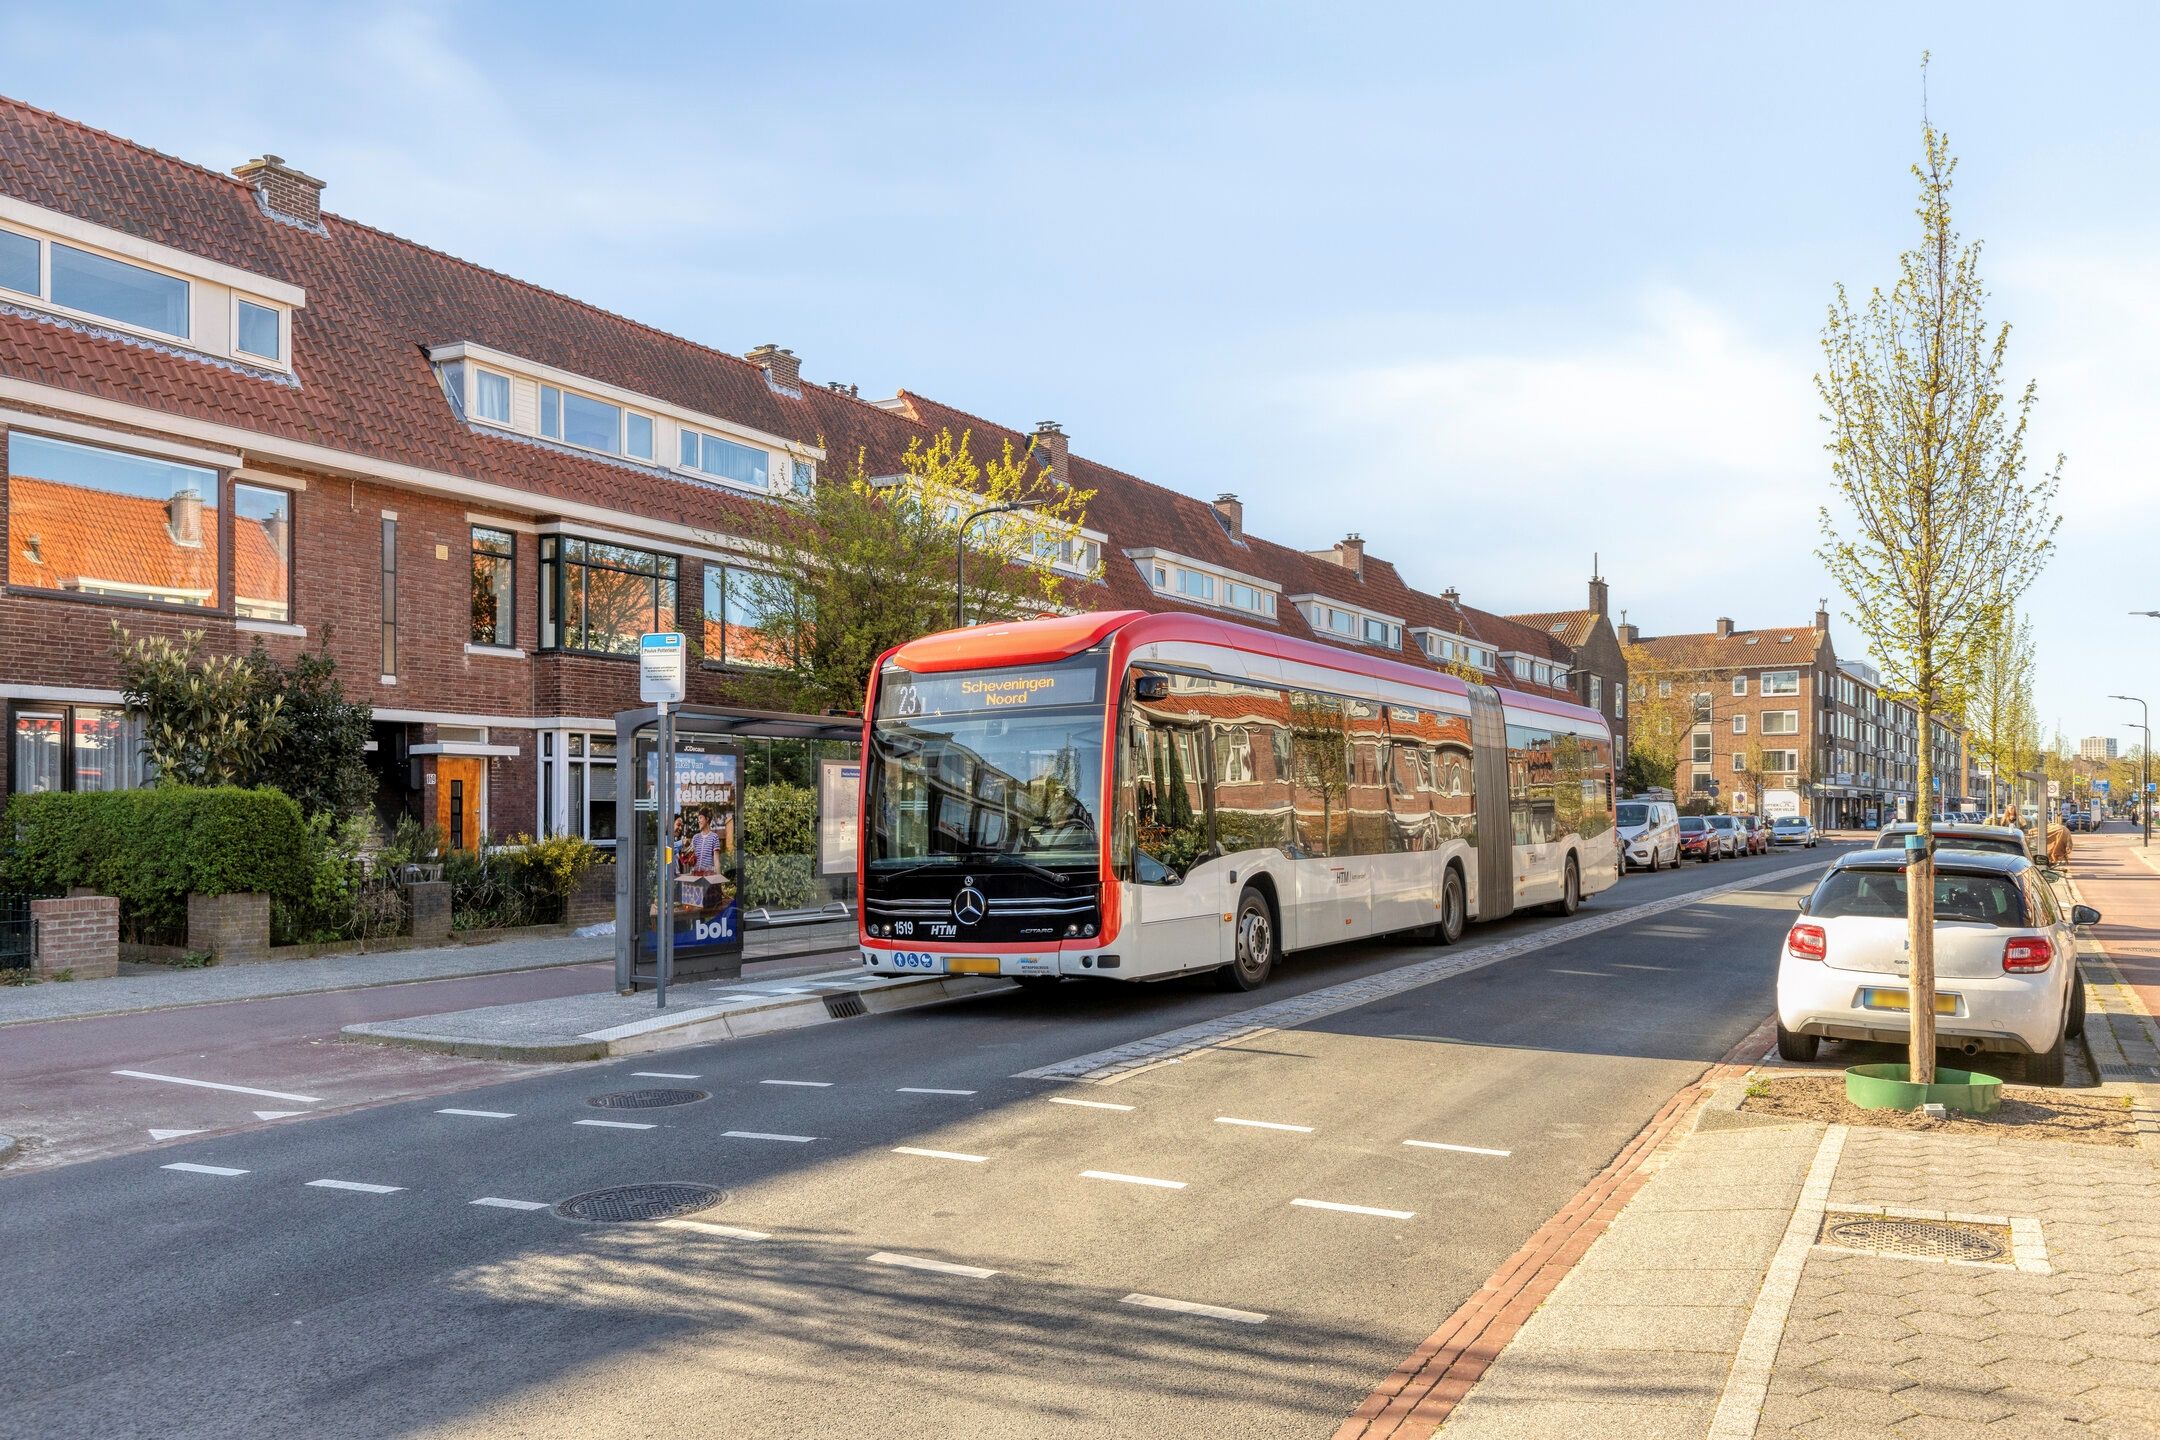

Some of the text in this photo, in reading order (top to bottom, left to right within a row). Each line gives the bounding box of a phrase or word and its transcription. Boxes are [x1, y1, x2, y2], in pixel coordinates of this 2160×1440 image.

[961, 677, 1055, 694] Scheveningen
[898, 685, 917, 715] 23
[986, 691, 1028, 706] Noord
[695, 917, 733, 941] bol.
[894, 921, 914, 936] 1519
[931, 924, 957, 936] HTM
